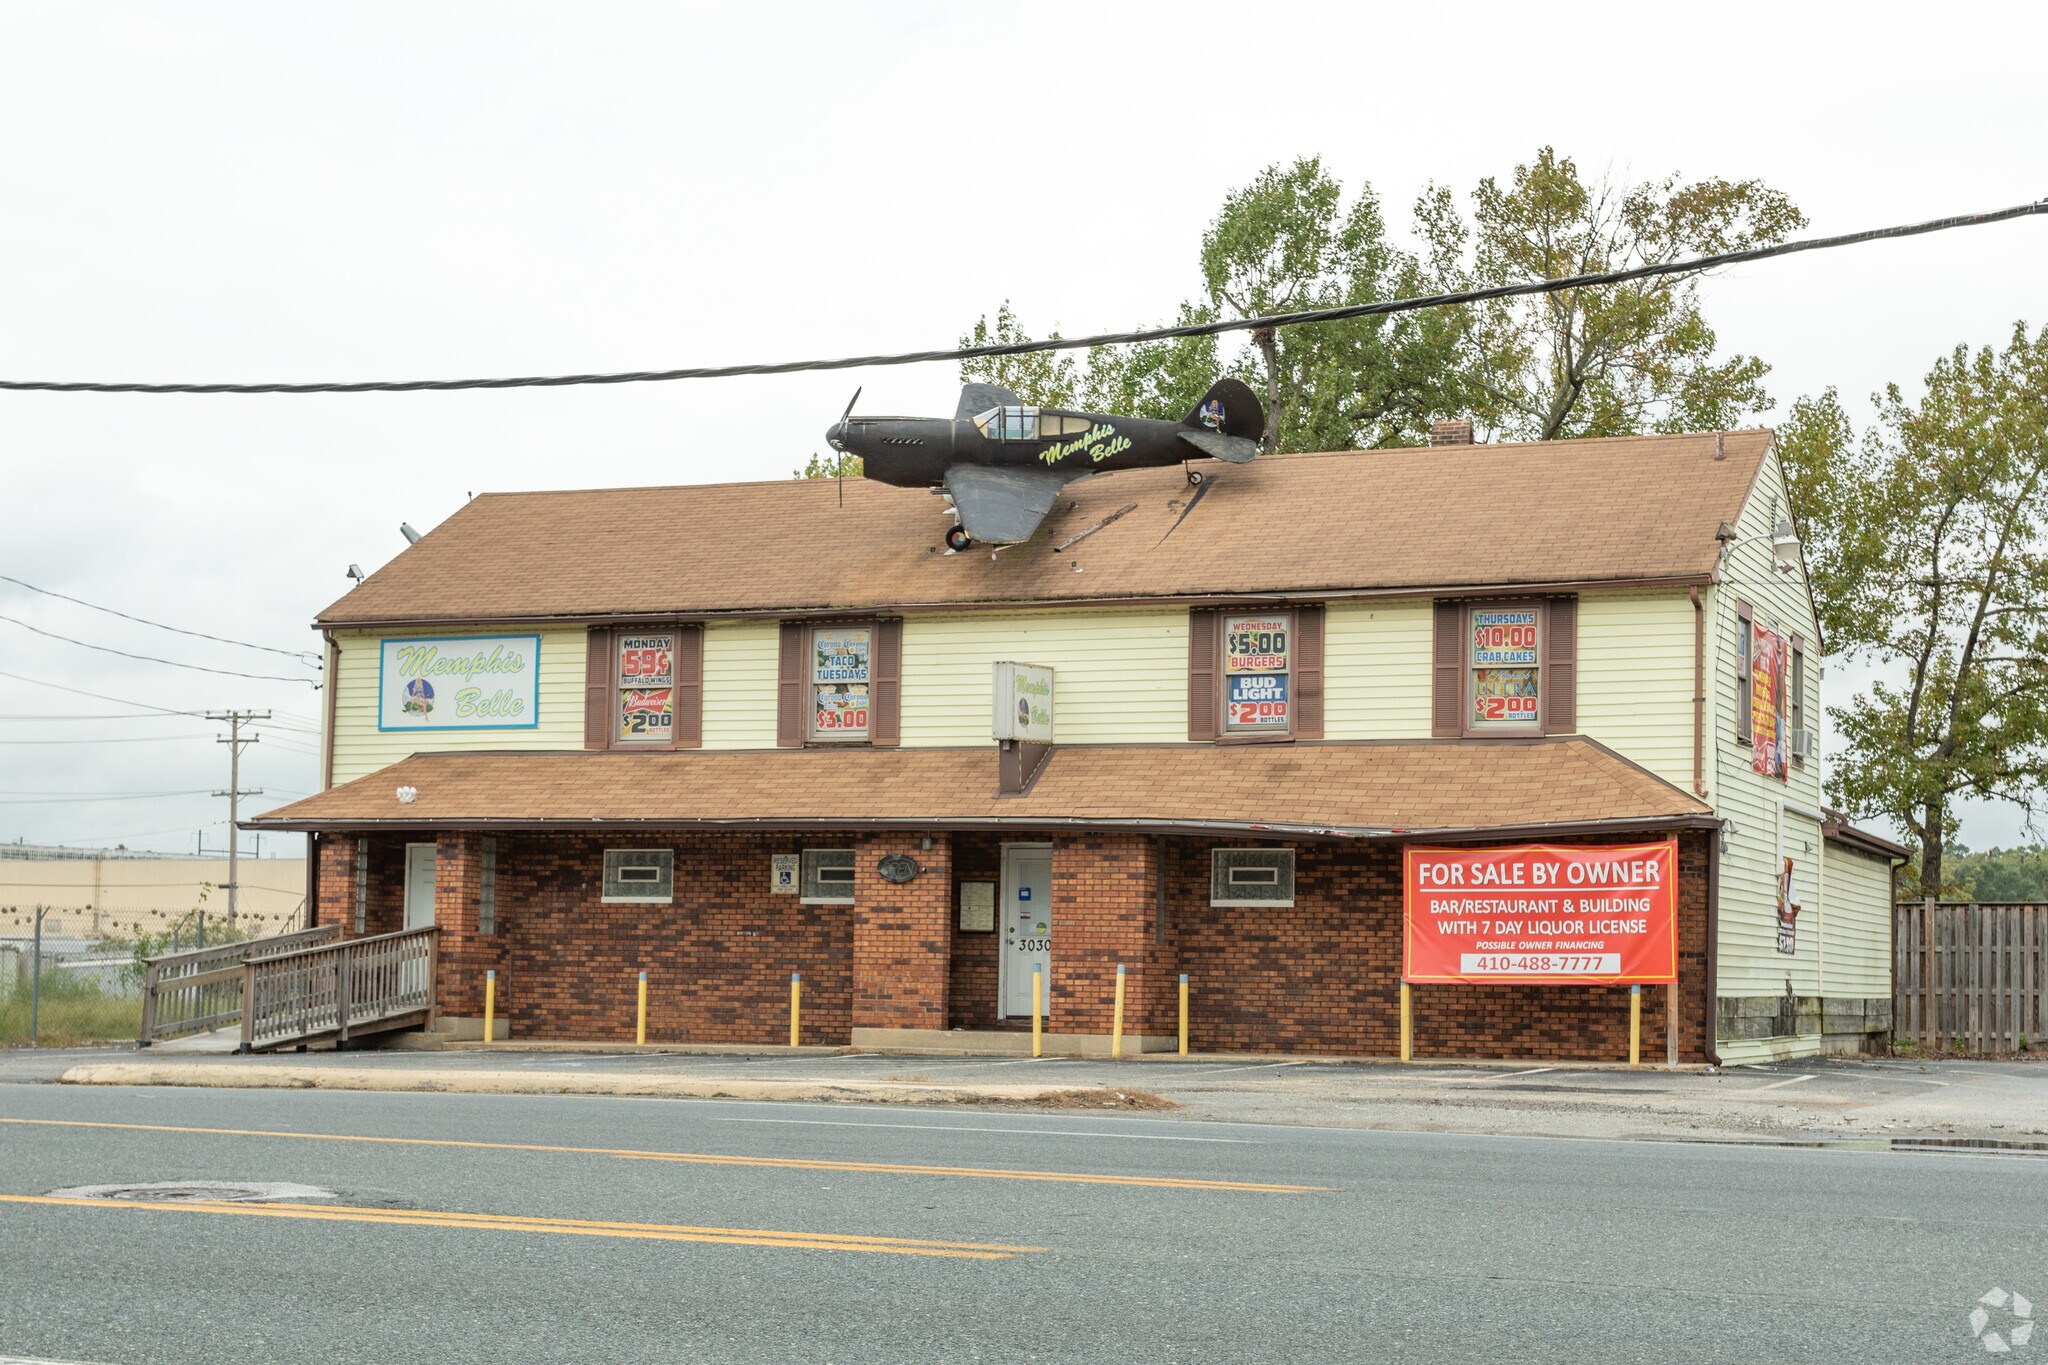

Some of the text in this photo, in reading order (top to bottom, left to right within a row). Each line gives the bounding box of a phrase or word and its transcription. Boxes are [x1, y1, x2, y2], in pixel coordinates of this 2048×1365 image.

[1039, 424, 1115, 466] Memphis
[1089, 435, 1132, 462] Belle
[1479, 614, 1534, 624] THURSDAYS
[1233, 622, 1282, 631] WEDNESDAY
[1229, 632, 1286, 654] $5.00
[1475, 627, 1536, 647] $10.00
[624, 639, 670, 649] MONDAY
[625, 649, 668, 674] 59¢
[830, 656, 854, 666] TACO
[1231, 656, 1283, 667] BURGERS
[1476, 651, 1534, 662] CRAB CAKES
[397, 645, 525, 682] Memphis
[623, 676, 670, 685] BUFFALO WINGS
[817, 669, 867, 680] TUESDAYS
[1240, 677, 1276, 689] BUD
[1477, 681, 1536, 696] ULTRA
[1233, 688, 1283, 700] LIGHT
[455, 687, 524, 718] Belle
[627, 695, 667, 707] Budweiser
[818, 710, 867, 728] $3.00
[774, 857, 797, 865] RESERVED
[882, 861, 914, 875] OPEN
[1419, 860, 1660, 885] FOR SALE BY OWNER
[1430, 898, 1651, 916] BAR/RESTAURANT & BUILDING
[1437, 919, 1647, 936] WITH 7 DAY LIQUOR LICENSE
[1019, 939, 1051, 952] 3030
[1476, 941, 1605, 950] POSSIBLE OWNER FINANCING
[1477, 956, 1603, 971] 410-488-7777
